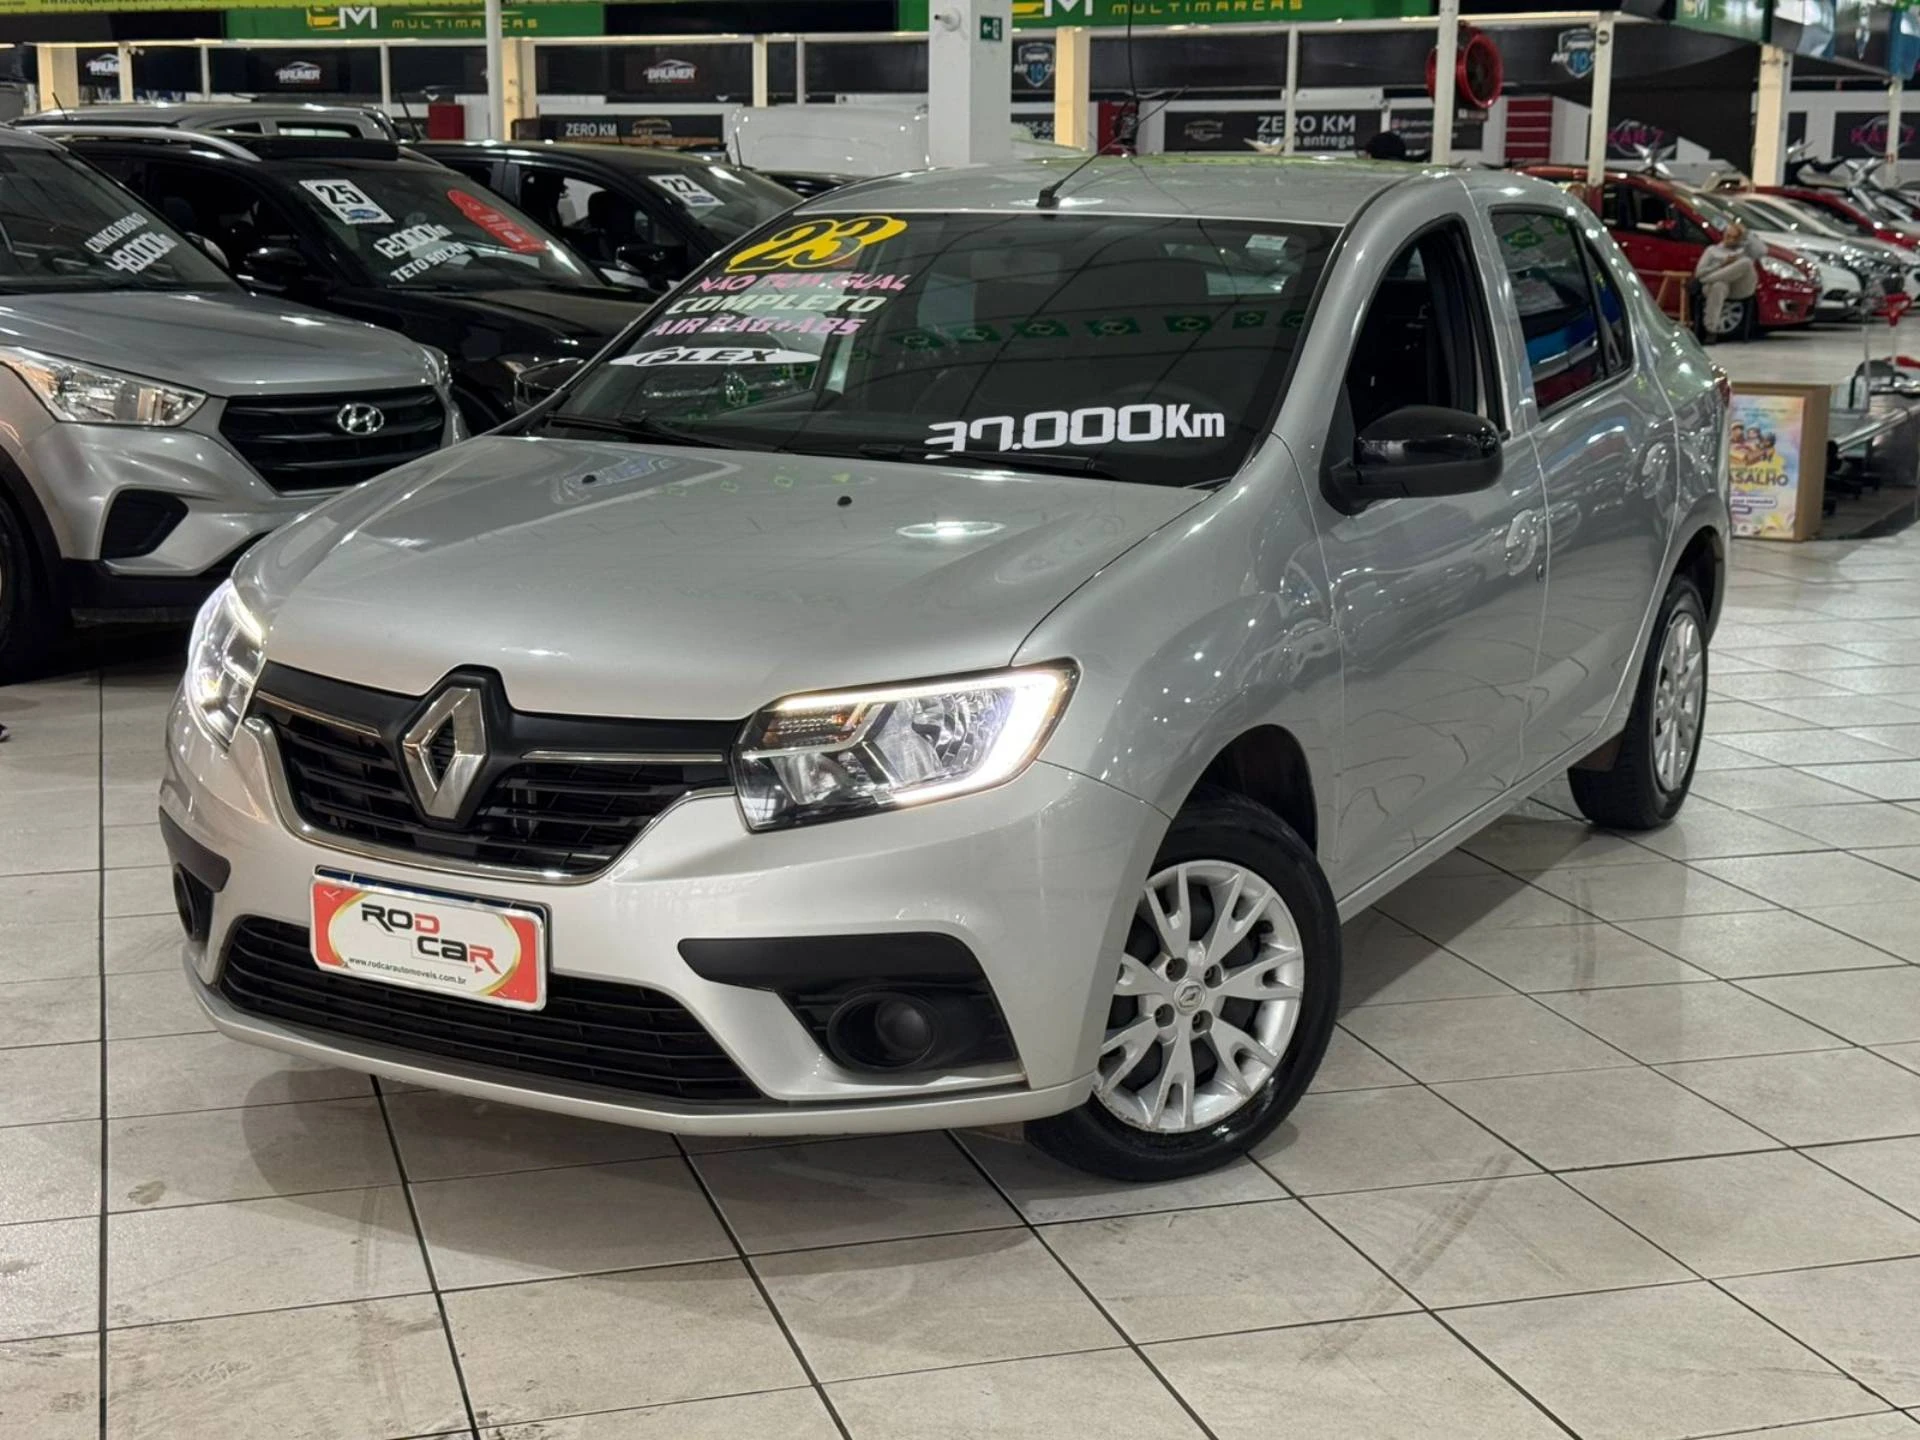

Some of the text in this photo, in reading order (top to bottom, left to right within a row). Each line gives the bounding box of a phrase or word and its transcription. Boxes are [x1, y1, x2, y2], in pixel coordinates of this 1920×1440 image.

[1112, 0, 1303, 15] MULTIMARCAS
[391, 18, 538, 30] MULTIMACAS
[565, 122, 597, 137] ZERO
[599, 122, 618, 137] KM
[1322, 115, 1356, 133] KM
[1303, 135, 1354, 149] entrega
[315, 185, 365, 204] 25
[662, 178, 701, 192] 22
[725, 216, 907, 272] 23
[390, 241, 470, 282] TETO SOLAR
[666, 294, 887, 315] COMPLETO
[642, 317, 709, 337] AIR
[635, 347, 772, 367] FLEX
[361, 903, 441, 934] ROD
[349, 957, 467, 985] www.rodcarautomoveis.com.br
